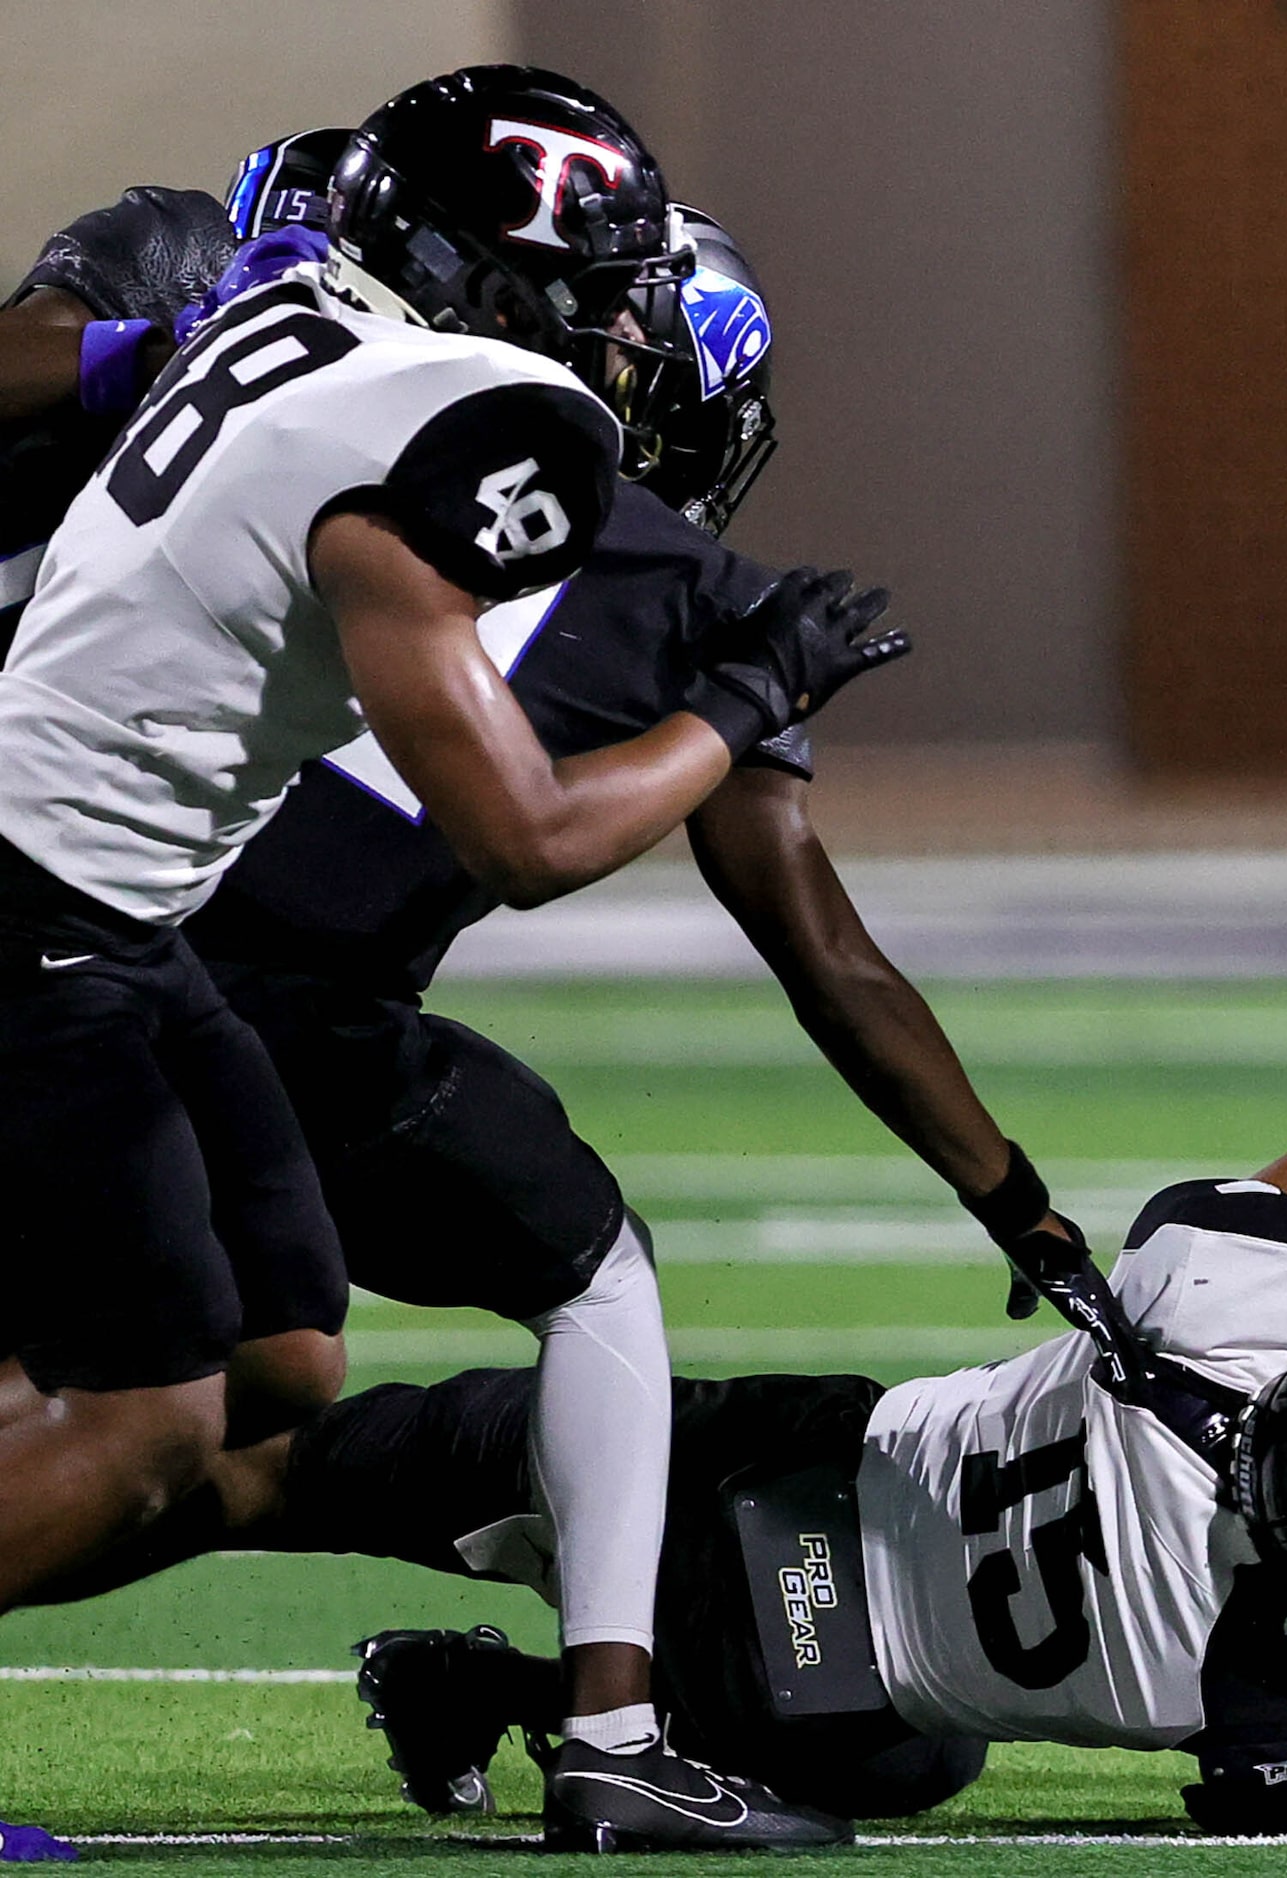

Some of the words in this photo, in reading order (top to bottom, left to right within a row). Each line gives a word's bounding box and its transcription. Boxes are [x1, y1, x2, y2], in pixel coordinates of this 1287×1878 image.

[273, 189, 312, 221] 15
[483, 114, 632, 251] T
[799, 1533, 838, 1608] PRO
[960, 1428, 1109, 1690] 15
[779, 1567, 822, 1669] GEAR
